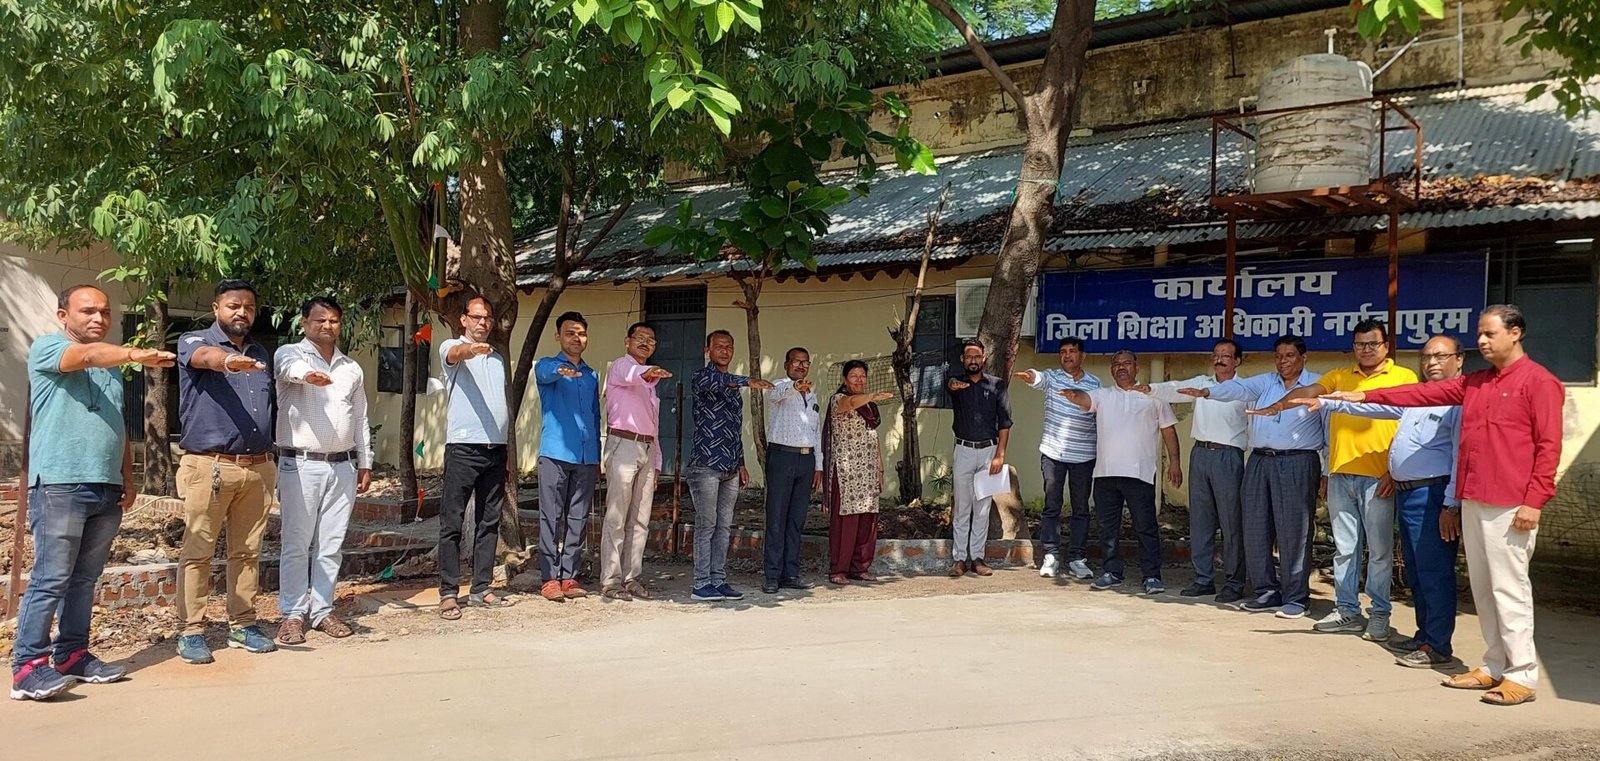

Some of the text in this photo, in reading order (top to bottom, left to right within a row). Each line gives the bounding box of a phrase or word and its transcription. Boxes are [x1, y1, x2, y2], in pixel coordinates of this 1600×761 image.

[1152, 266, 1338, 300] कार्यालय
[1046, 313, 1112, 341] जिला
[1117, 311, 1188, 340] शिक्षा
[1194, 306, 1316, 338] अधिकारी
